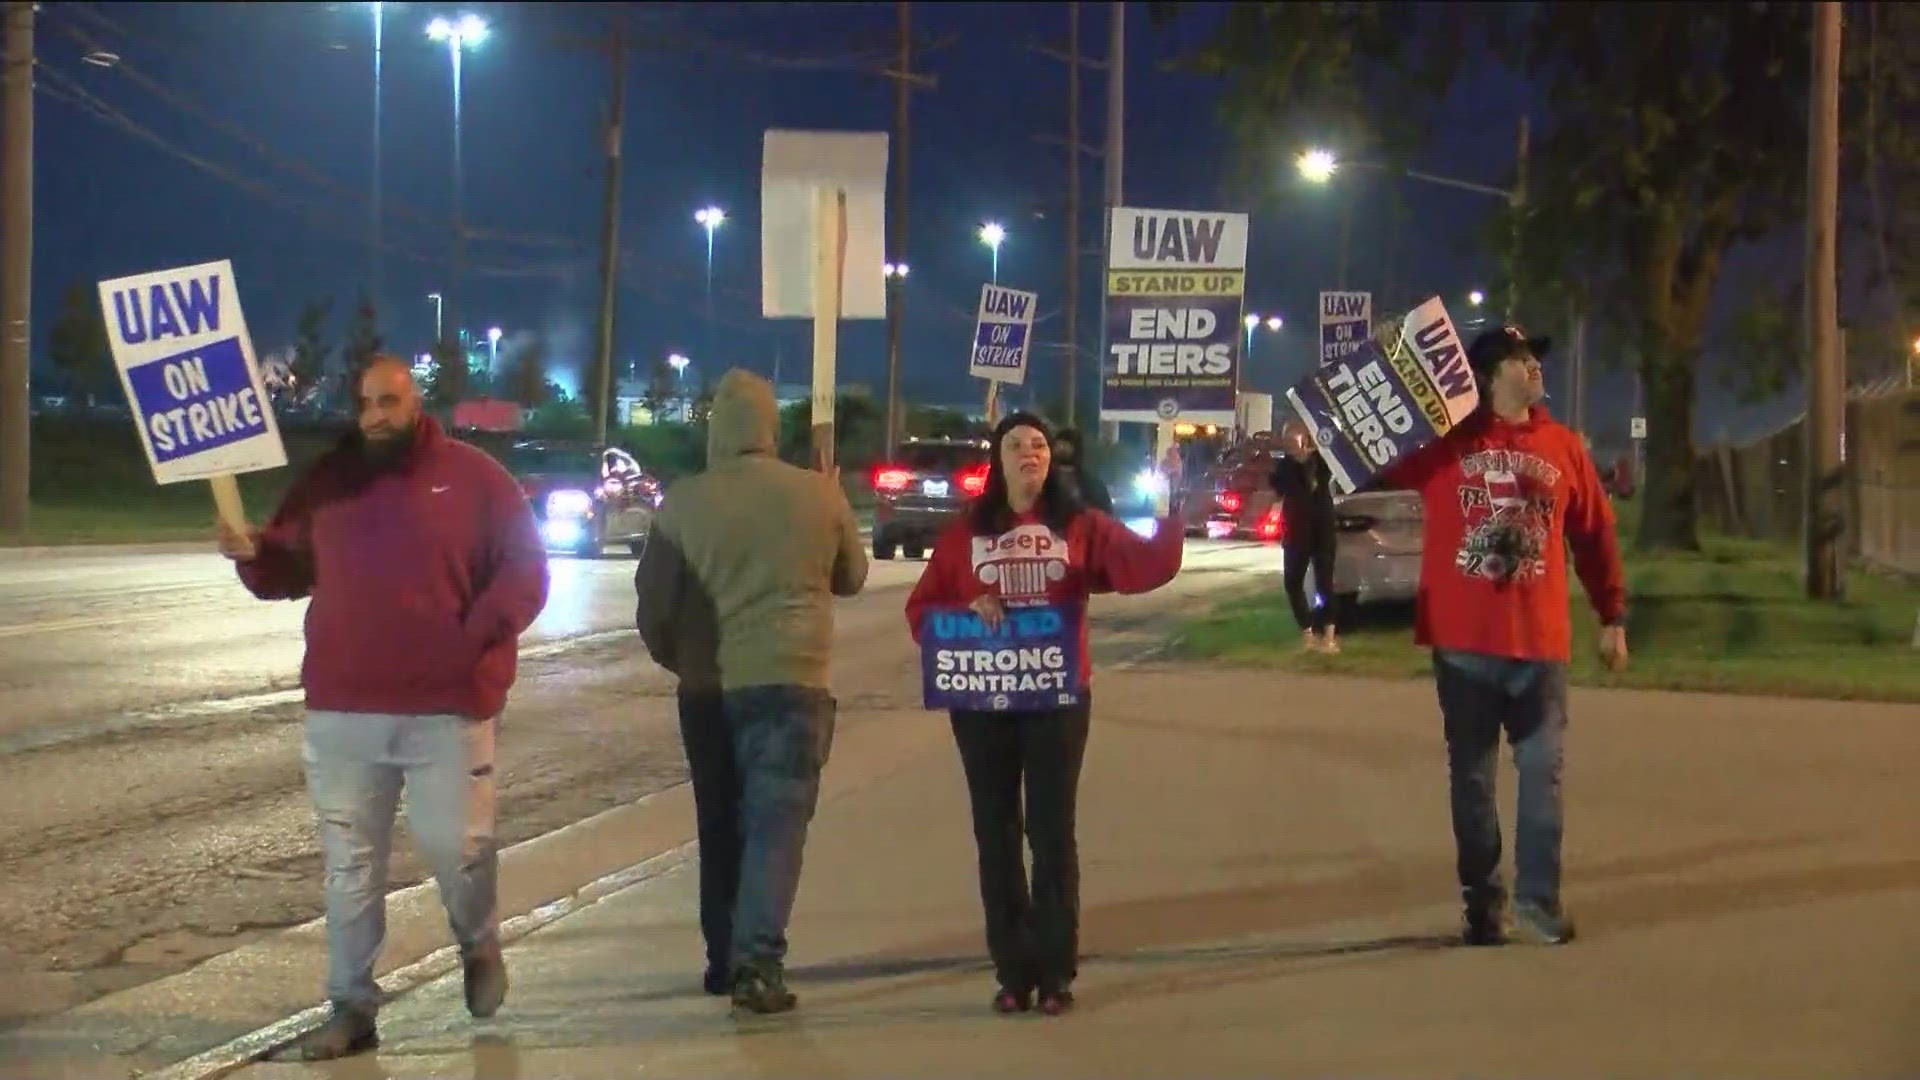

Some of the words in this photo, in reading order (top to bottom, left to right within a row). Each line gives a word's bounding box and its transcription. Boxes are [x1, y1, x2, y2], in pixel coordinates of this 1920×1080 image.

[1133, 216, 1225, 263] UAW
[1116, 276, 1195, 292] STAND
[1204, 277, 1235, 292] UP
[113, 275, 219, 345] UAW
[985, 289, 1029, 318] UAW
[1324, 295, 1365, 316] UAW
[991, 324, 1011, 344] ON
[1130, 308, 1216, 339] END
[977, 345, 1021, 366] STRIKE
[1111, 343, 1231, 375] TIERS
[1414, 317, 1473, 399] UAW
[163, 356, 210, 400] ON
[1356, 361, 1414, 434] END
[1425, 399, 1446, 426] UP
[150, 387, 262, 451] STRIKE
[1328, 362, 1398, 465] TIERS
[985, 534, 1052, 556] Jeep
[936, 646, 1064, 672] STRONG
[935, 671, 1067, 691] CONTRACT
